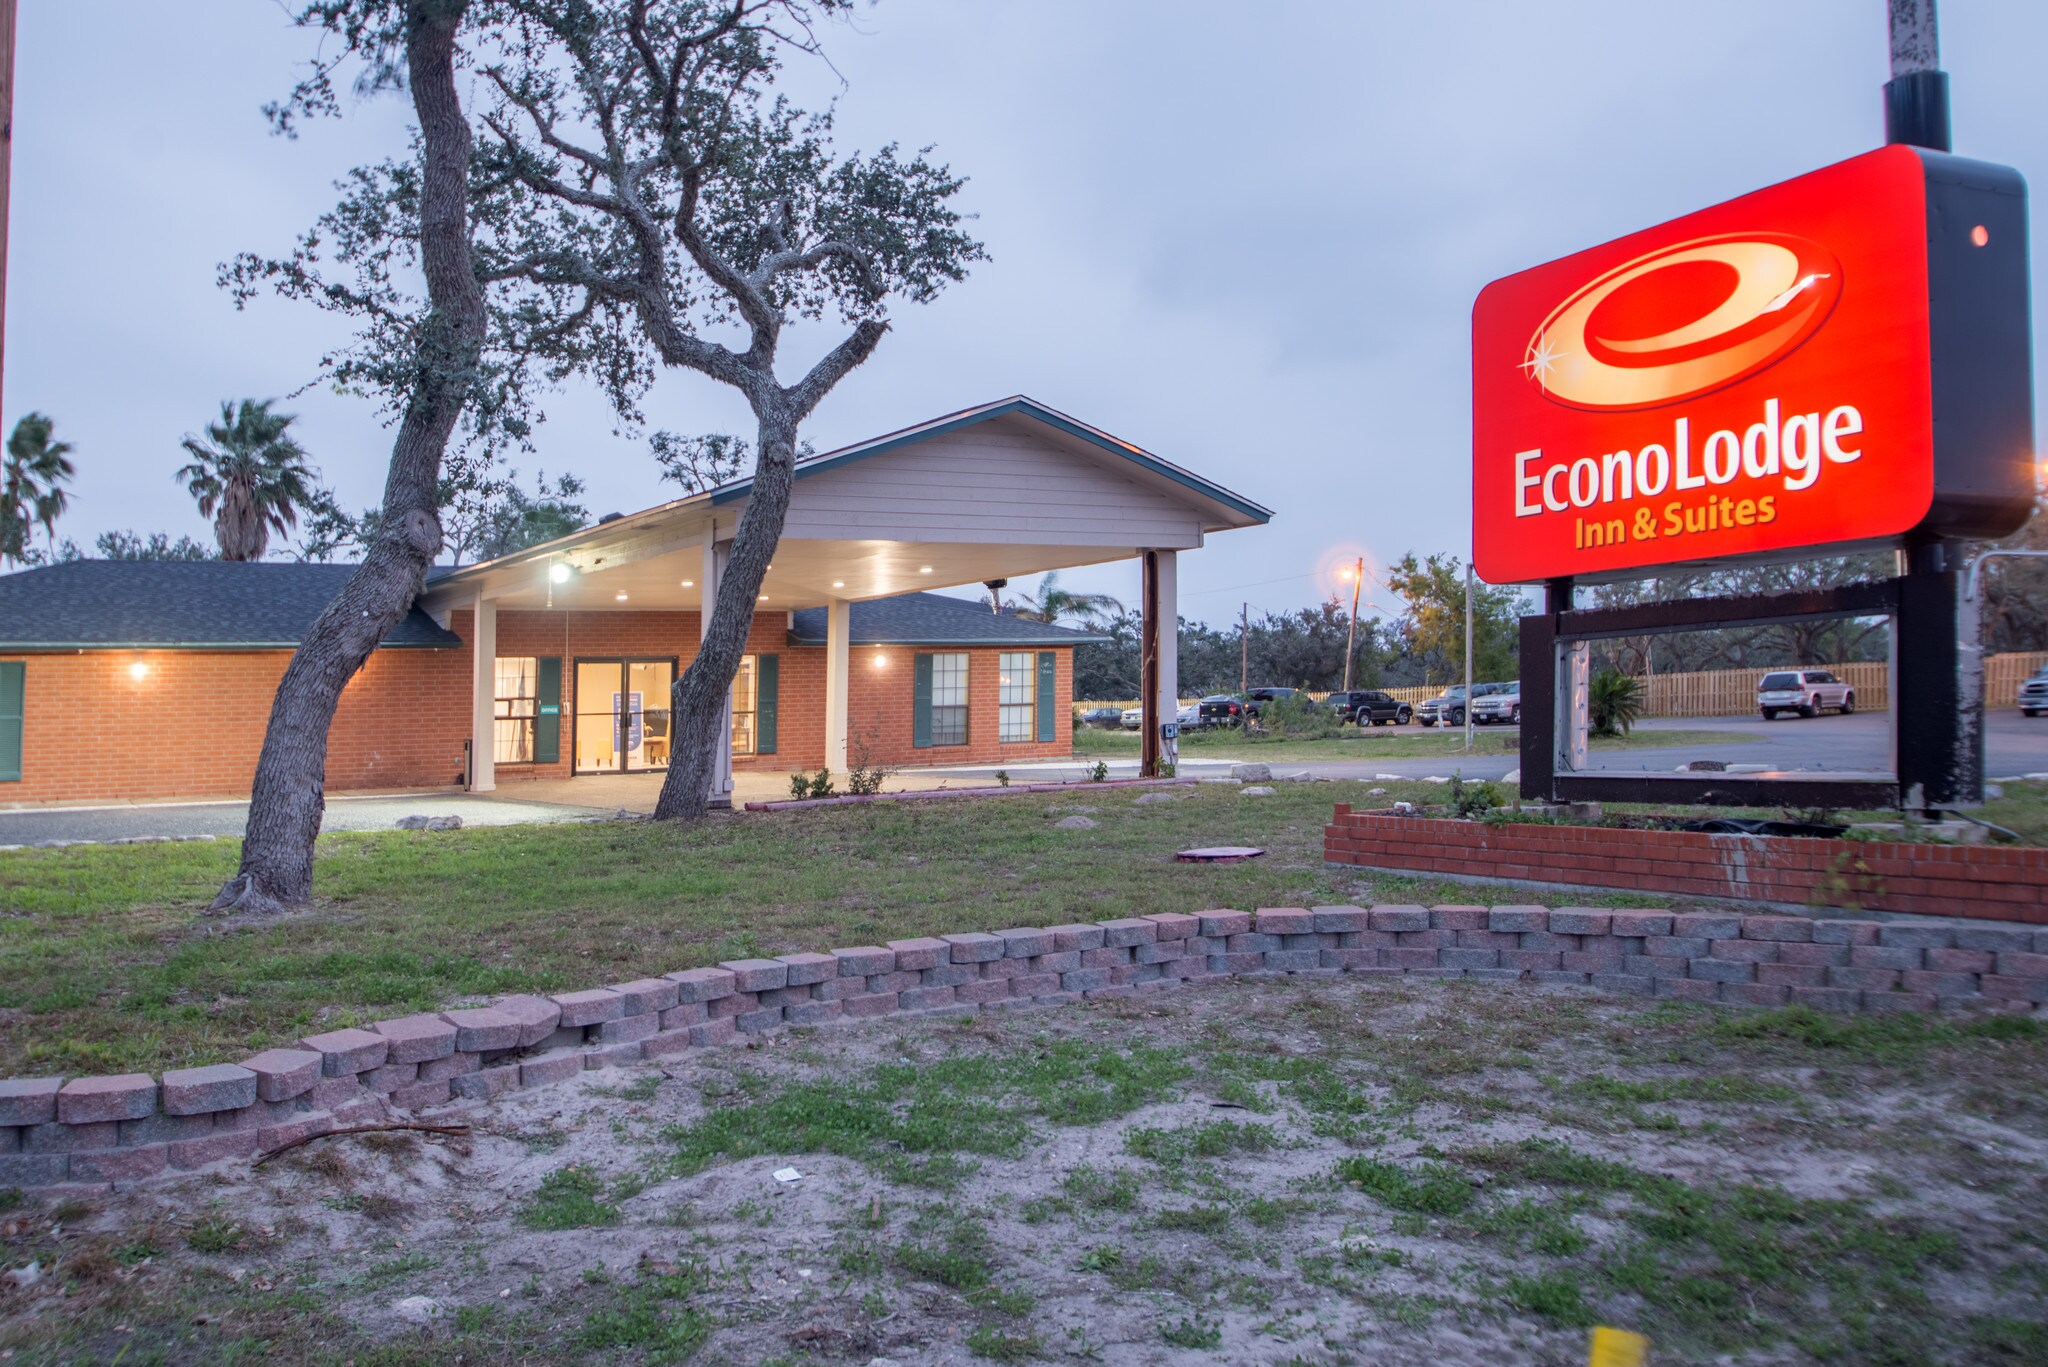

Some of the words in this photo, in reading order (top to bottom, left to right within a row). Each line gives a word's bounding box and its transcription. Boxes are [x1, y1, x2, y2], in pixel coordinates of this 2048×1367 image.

[1575, 518, 1625, 549] Inn
[1632, 507, 1657, 540] &
[1664, 495, 1776, 536] Suites
